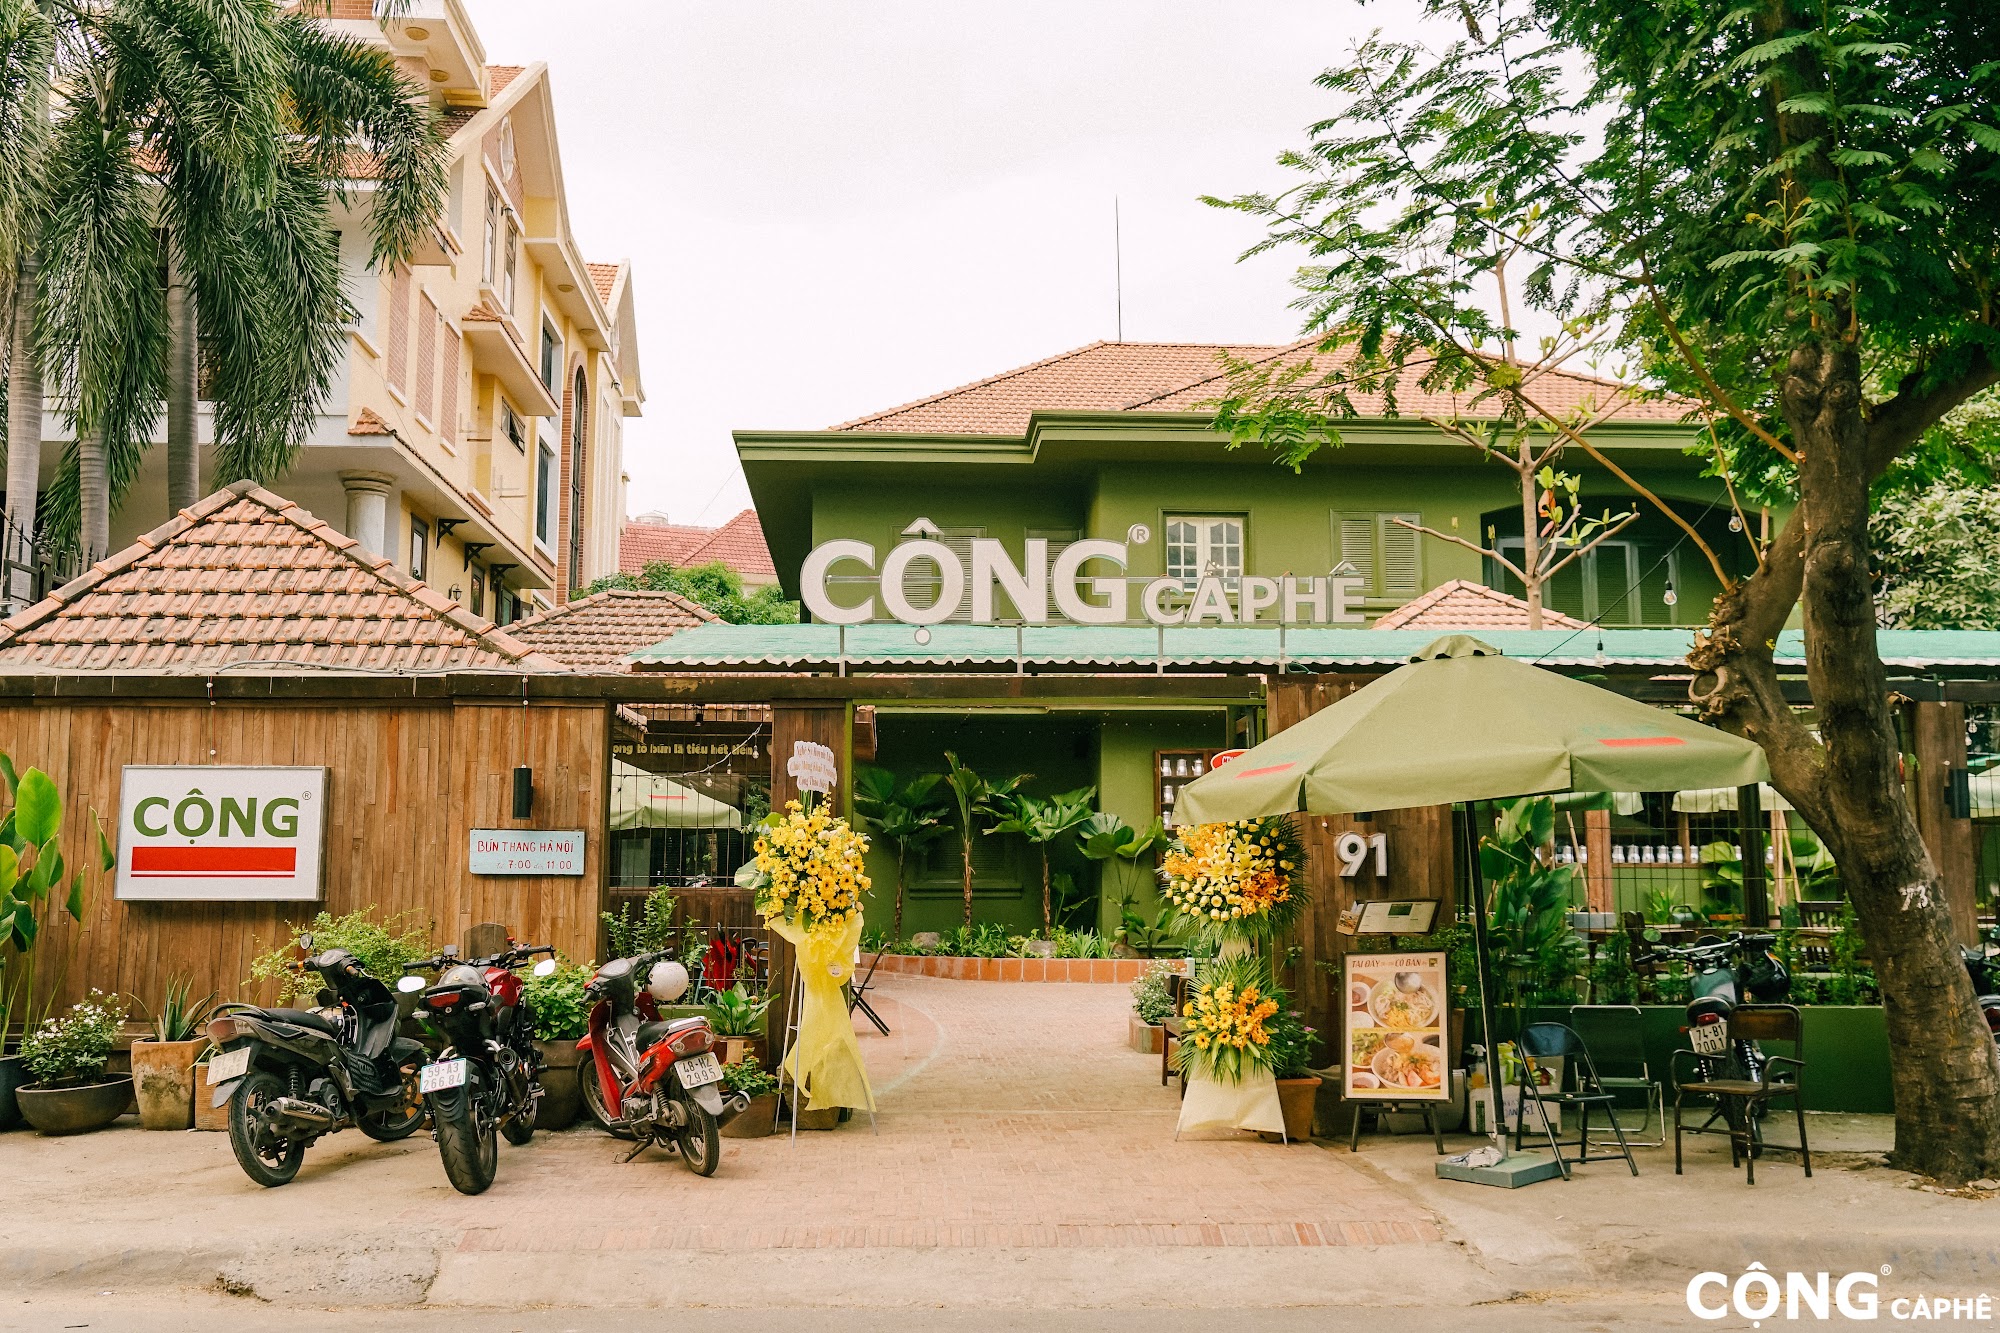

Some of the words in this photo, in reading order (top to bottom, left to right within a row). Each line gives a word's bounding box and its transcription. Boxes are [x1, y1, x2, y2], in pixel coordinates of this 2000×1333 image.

[800, 518, 1129, 646] CỘNG
[133, 788, 299, 845] CỘNG
[477, 838, 499, 853] BÚN
[502, 841, 536, 852] THANG
[540, 839, 553, 852] HÀ
[556, 839, 574, 855] NỘI
[1334, 831, 1388, 877] 91
[1696, 1024, 1724, 1041] 74-B1
[428, 1062, 459, 1078] 59-A3
[686, 1067, 716, 1086] 2995
[423, 1073, 462, 1091] 266.84
